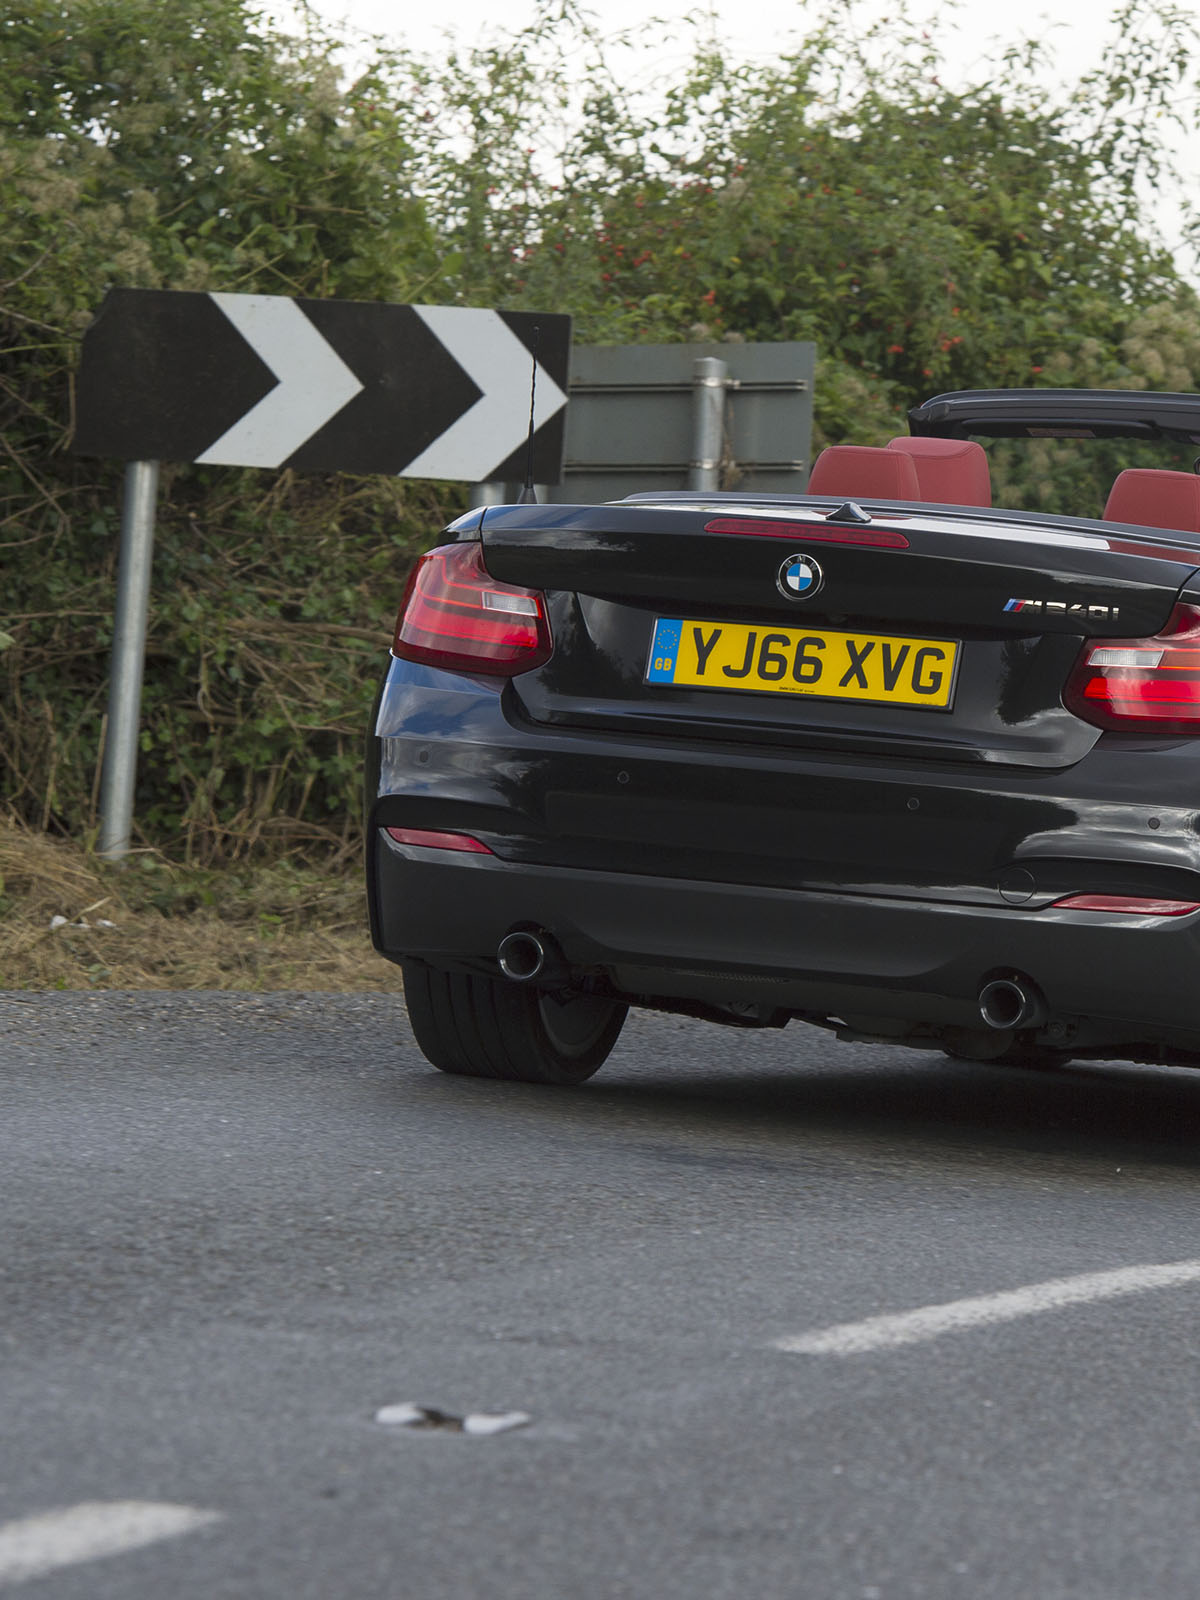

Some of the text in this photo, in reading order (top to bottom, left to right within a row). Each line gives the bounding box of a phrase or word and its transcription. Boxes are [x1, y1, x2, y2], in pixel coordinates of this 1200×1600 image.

[784, 555, 818, 571] BMW
[654, 657, 672, 671] GB
[693, 627, 946, 695] YJ66 XVG
